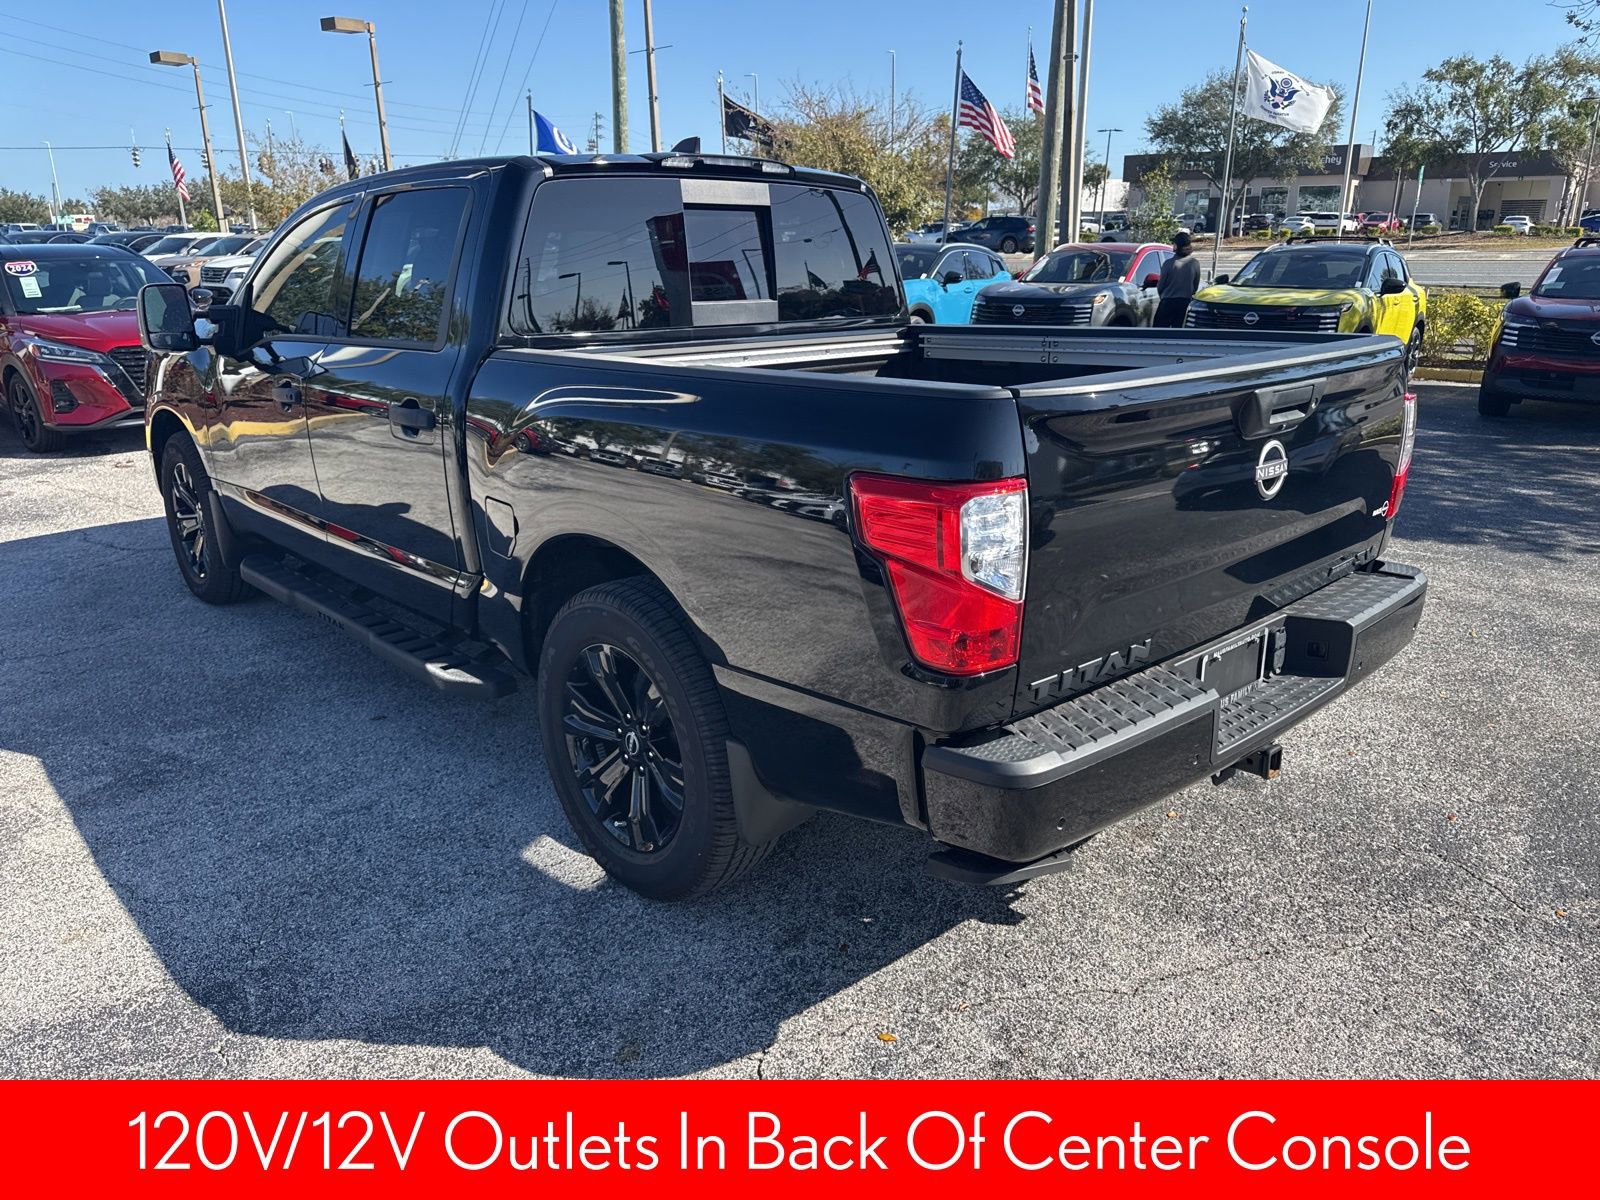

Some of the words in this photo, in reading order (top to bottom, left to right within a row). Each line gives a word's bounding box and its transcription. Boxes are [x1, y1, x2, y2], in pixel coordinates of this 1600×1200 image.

[9, 264, 33, 273] 2024
[1257, 461, 1288, 479] NISSAN
[1028, 638, 1152, 701] TITAN
[1230, 683, 1252, 705] FAMILY
